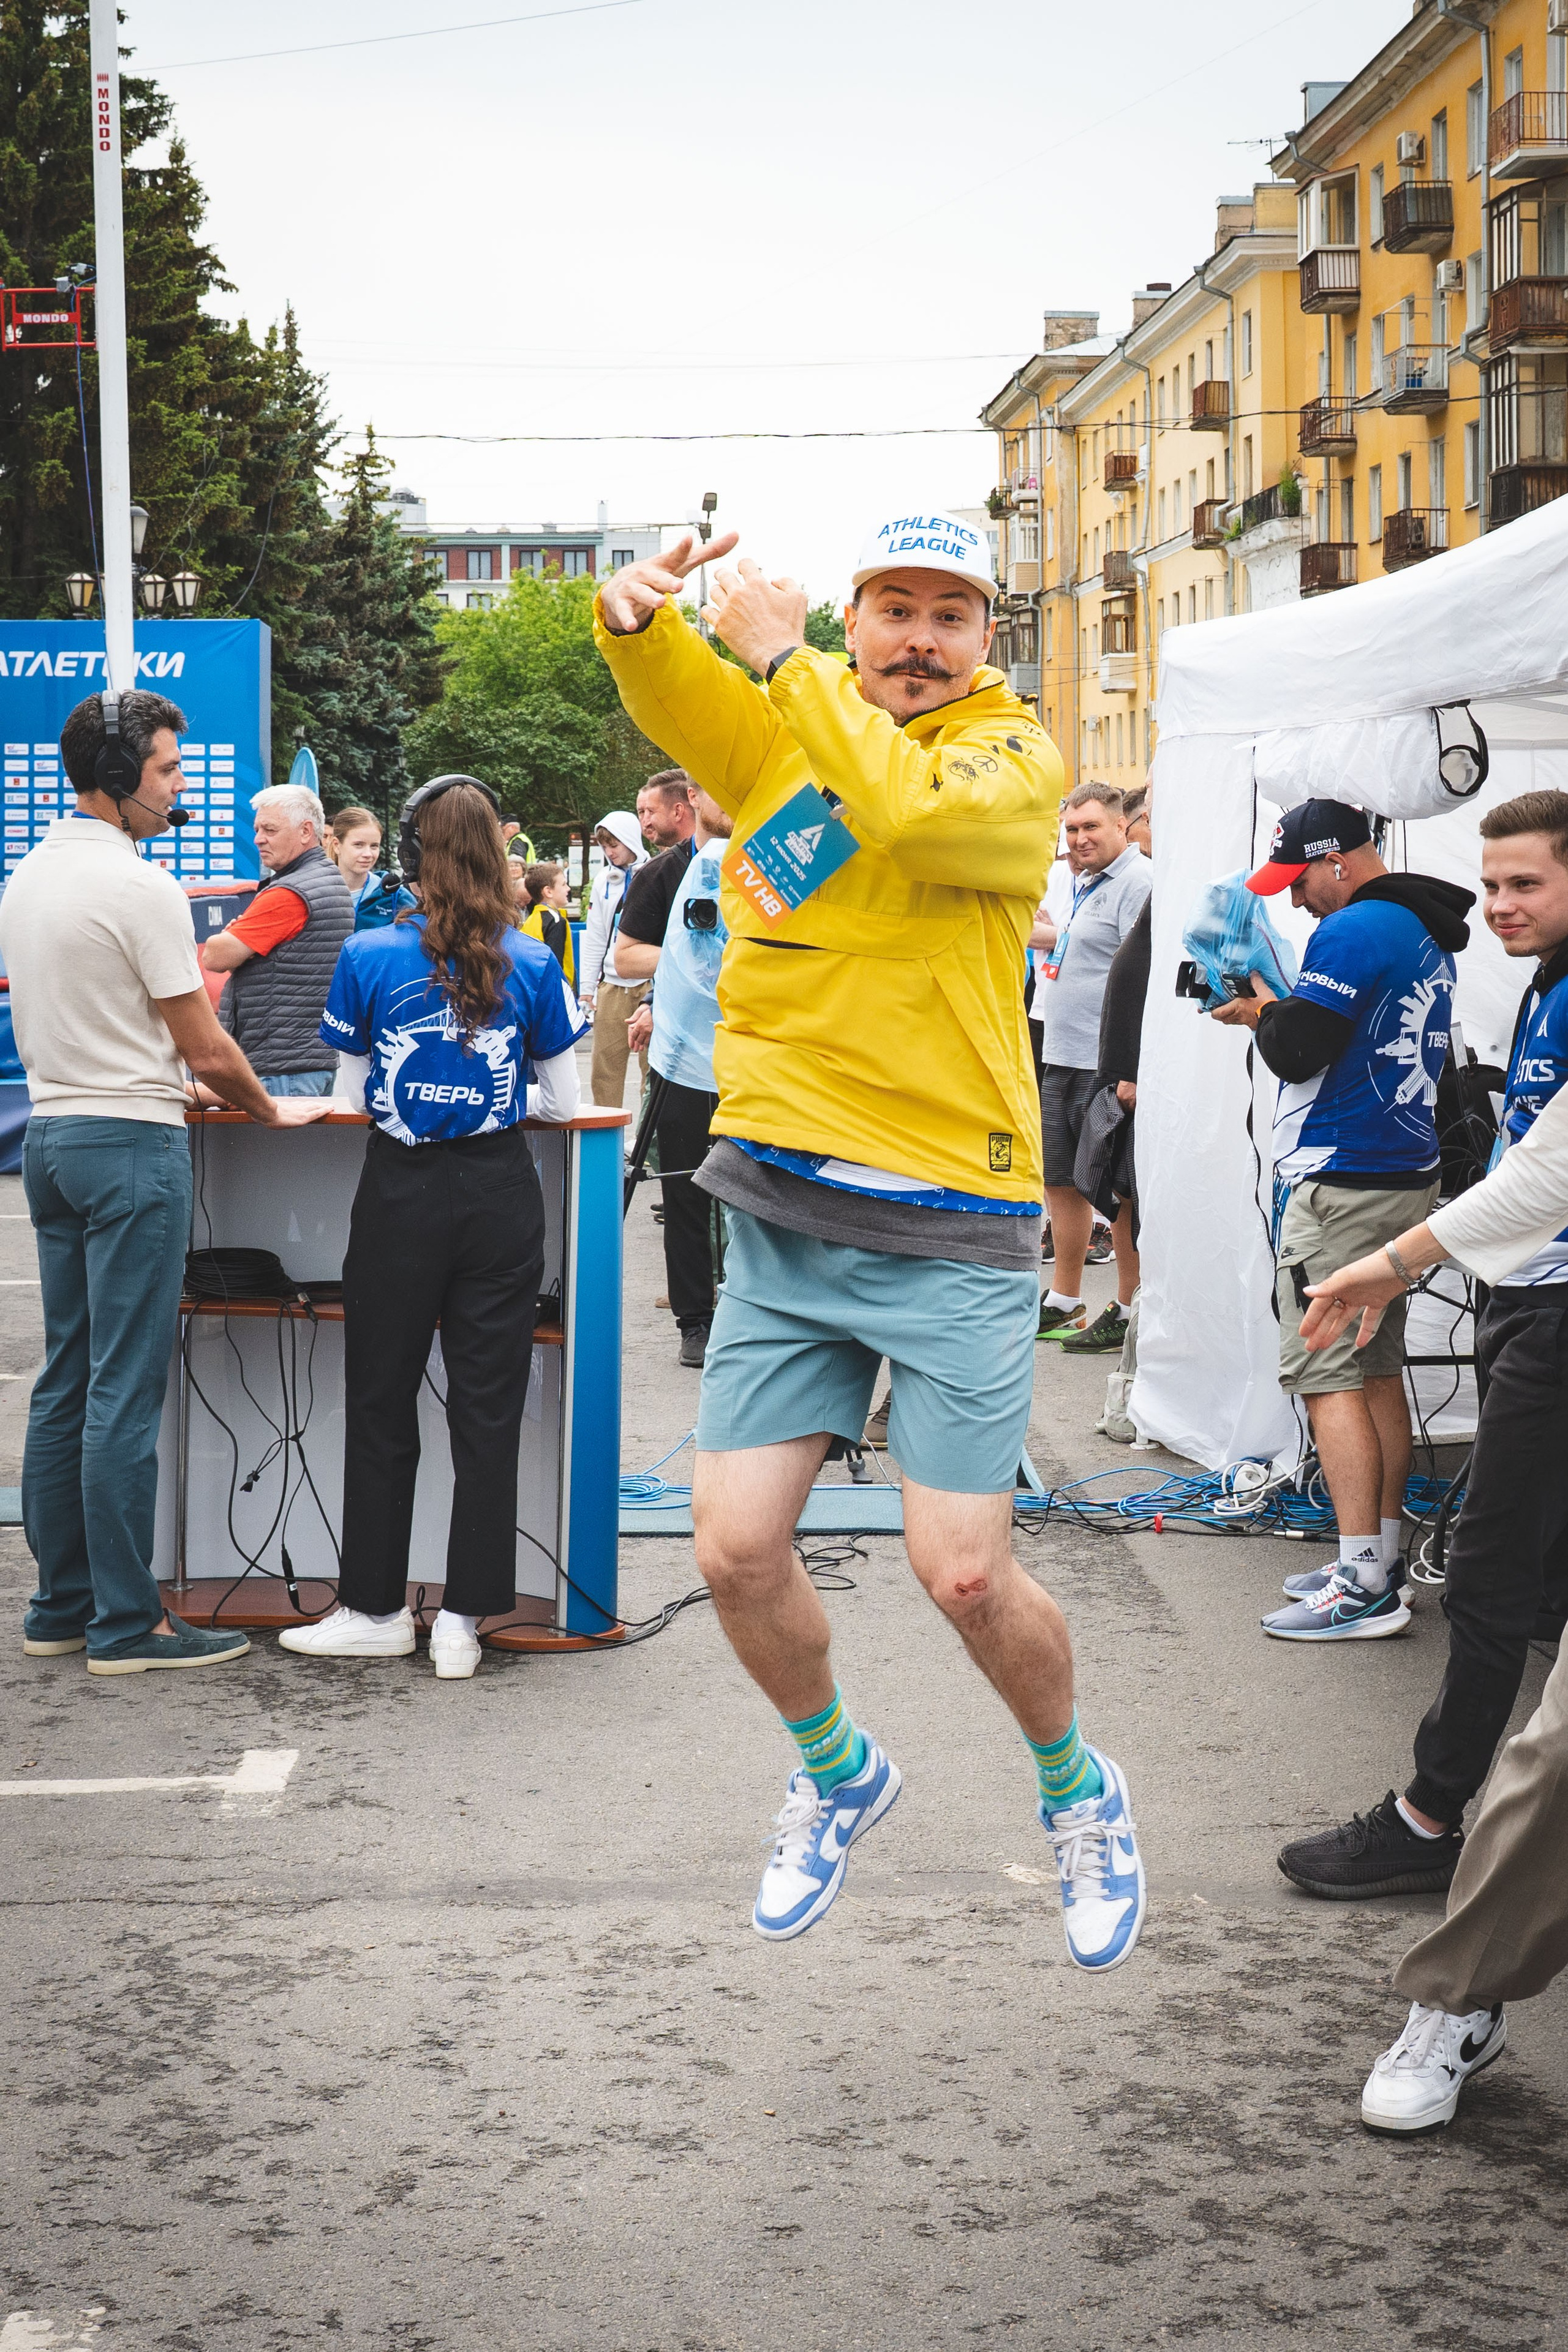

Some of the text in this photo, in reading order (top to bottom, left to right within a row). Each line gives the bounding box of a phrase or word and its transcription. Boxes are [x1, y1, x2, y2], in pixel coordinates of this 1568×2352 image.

[97, 88, 110, 151] MONDO
[23, 314, 69, 323] MONDO
[878, 516, 978, 545] ATHLETICS
[888, 537, 967, 560] LEAGUE
[0, 650, 185, 677] ТЛЕТКИ
[770, 835, 778, 846] 12
[790, 862, 807, 881] 2025
[1303, 837, 1340, 853] RUSSIA
[735, 859, 763, 887] TV
[753, 886, 782, 917] HB
[404, 1082, 484, 1105] ТВЕРЬ
